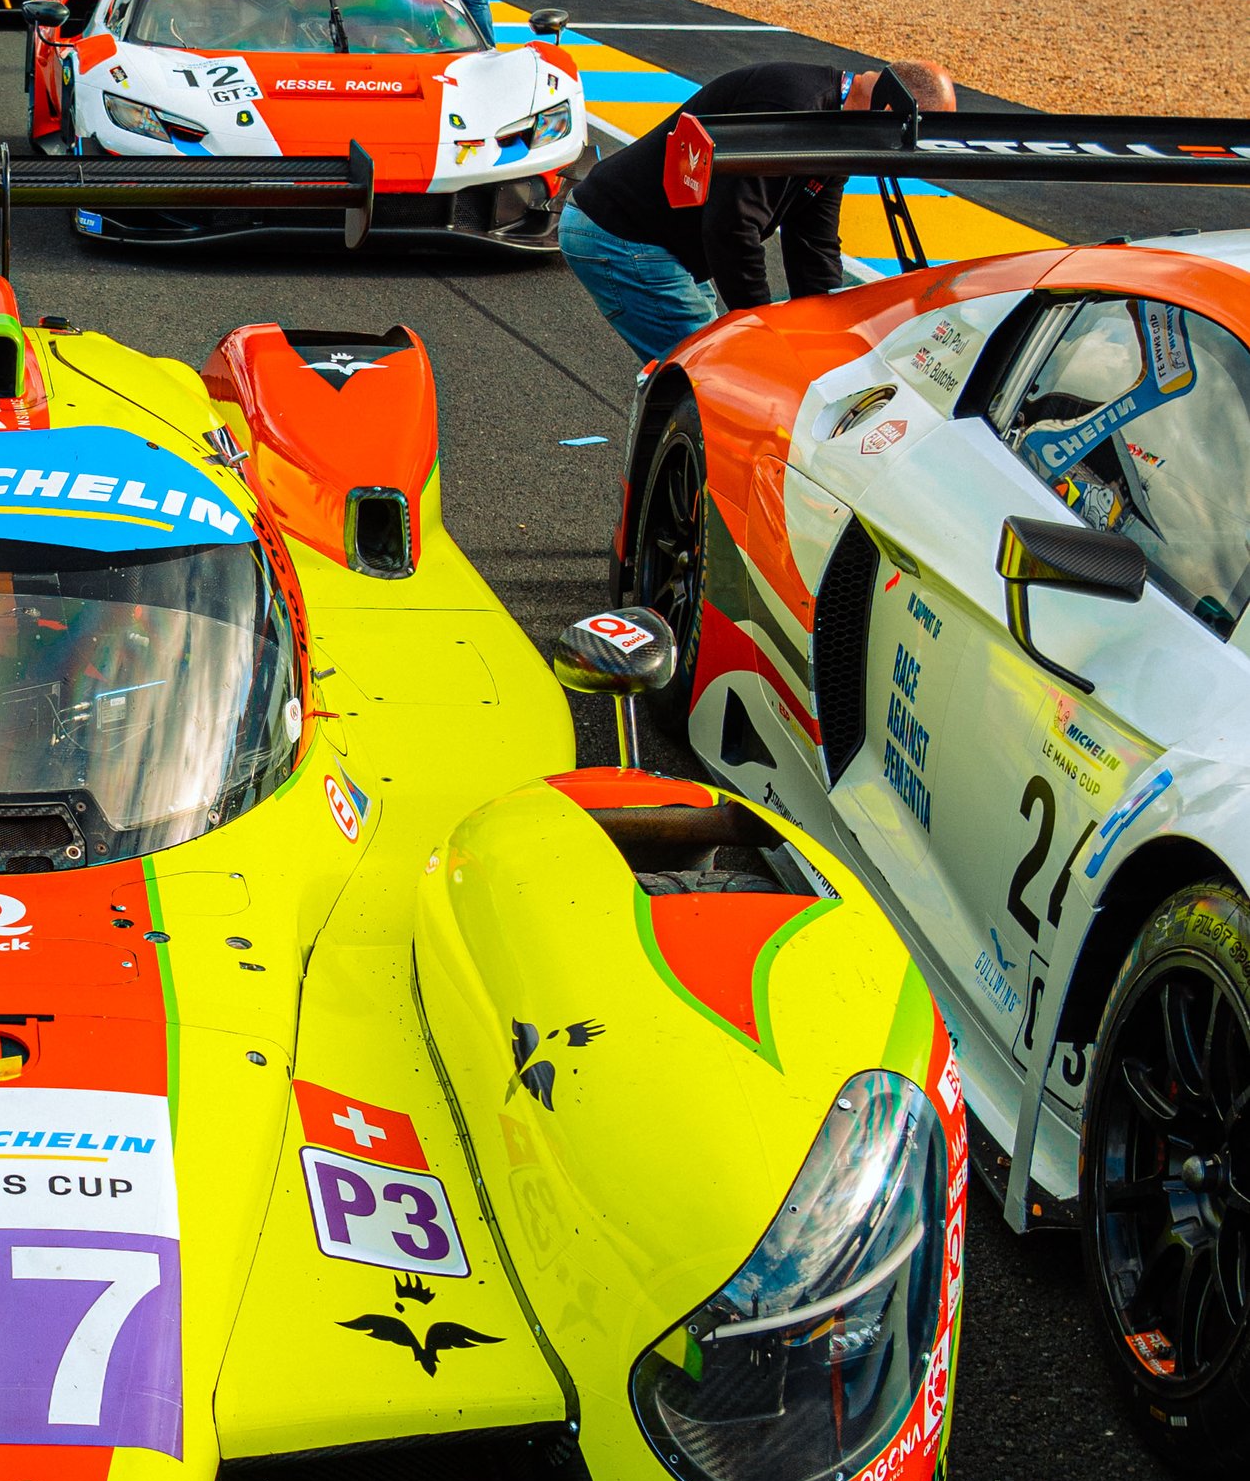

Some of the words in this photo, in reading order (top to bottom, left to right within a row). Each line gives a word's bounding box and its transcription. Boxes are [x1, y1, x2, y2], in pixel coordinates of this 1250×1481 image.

[172, 65, 245, 89] 12
[212, 85, 259, 104] GT3
[275, 78, 336, 92] KESSEL
[345, 80, 403, 92] RACING
[952, 332, 970, 356] Paul
[930, 362, 958, 392] Butcher
[913, 598, 936, 633] SUPPORT
[932, 620, 943, 641] OF
[622, 632, 648, 648] Quick
[892, 642, 921, 705] RACE
[886, 691, 930, 772] AGAINST
[1066, 724, 1121, 771] MICHELIN
[883, 738, 931, 834] DEMENTIA
[1042, 739, 1052, 757] LE
[1053, 748, 1078, 781] MANS
[1079, 773, 1101, 796] CUP
[1192, 914, 1233, 947] PILOT
[975, 951, 1018, 1013] GULLWING
[48, 1175, 133, 1199] CUP
[314, 1161, 451, 1262] P3
